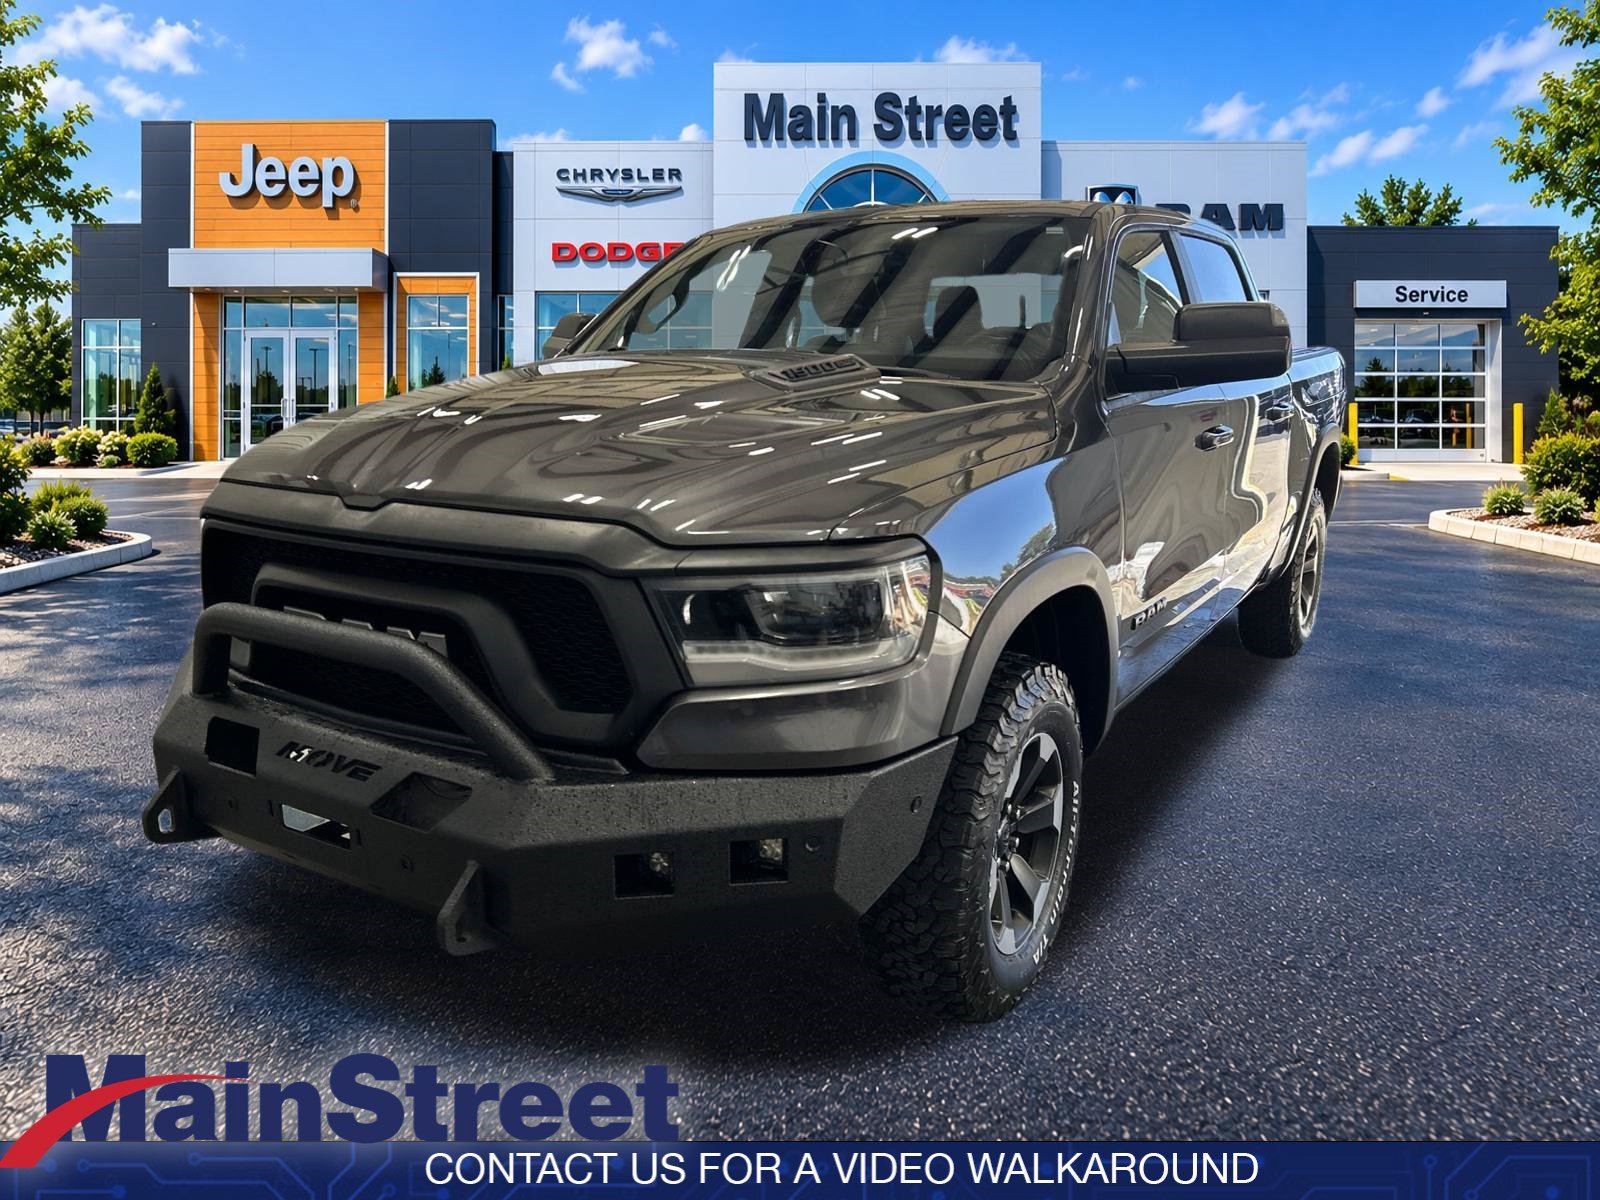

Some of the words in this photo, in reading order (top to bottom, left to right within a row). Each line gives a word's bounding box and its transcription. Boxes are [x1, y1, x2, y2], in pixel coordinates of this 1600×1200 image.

[744, 93, 856, 141] Main
[873, 92, 1018, 141] Street
[219, 143, 355, 208] Jeep
[556, 168, 683, 182] CHRYSLER
[1395, 286, 1469, 303] Service
